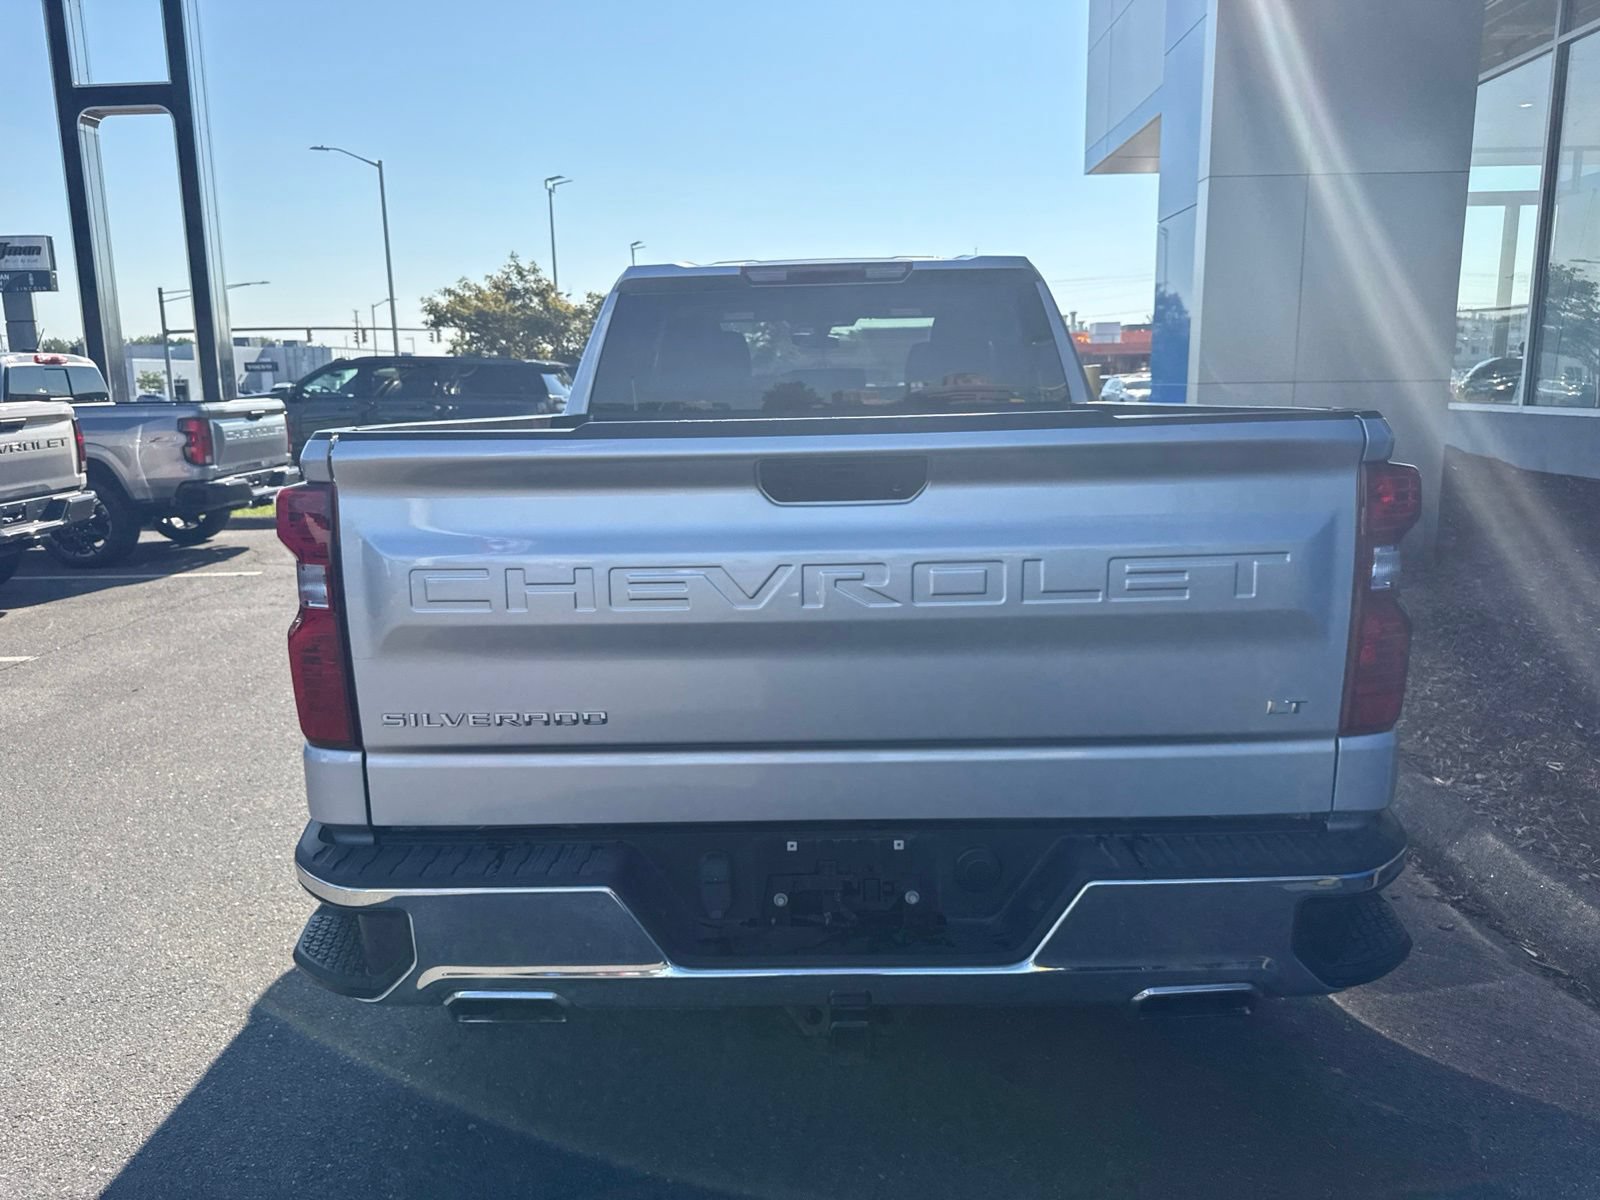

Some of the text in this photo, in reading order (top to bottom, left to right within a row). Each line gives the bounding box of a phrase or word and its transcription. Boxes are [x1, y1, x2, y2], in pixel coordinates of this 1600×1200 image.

[408, 551, 1291, 613] CHEVROLET
[1266, 699, 1309, 715] LT
[381, 711, 609, 728] SILVERADO
